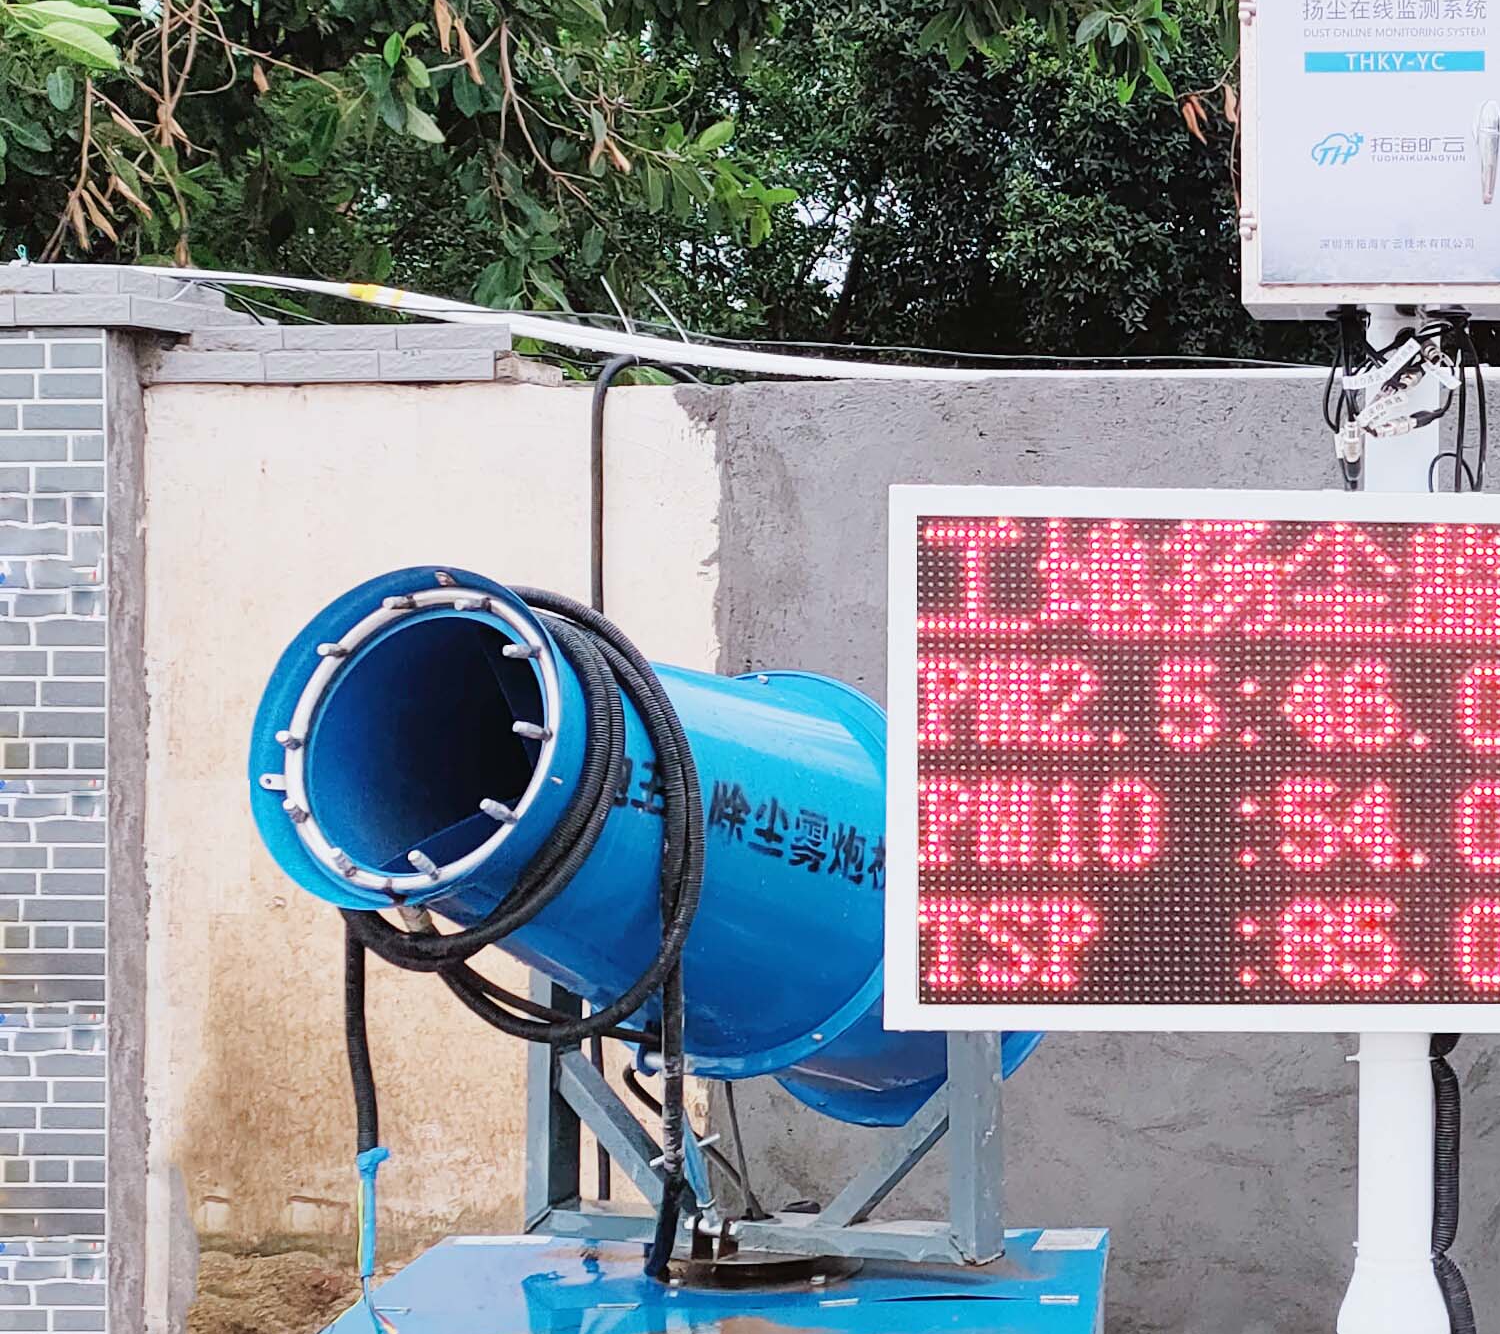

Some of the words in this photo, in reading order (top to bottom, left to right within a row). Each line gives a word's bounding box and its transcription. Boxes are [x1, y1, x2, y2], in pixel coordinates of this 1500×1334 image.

[1303, 28, 1330, 38] DUST
[1333, 28, 1372, 38] ONLINE
[1375, 27, 1444, 37] MONITORING
[1447, 27, 1487, 37] SYSTEM
[1345, 52, 1446, 71] THKY-YC
[1370, 136, 1465, 153] 拓海旷云
[916, 779, 1158, 866] PM10
[917, 900, 1094, 986] TSP
